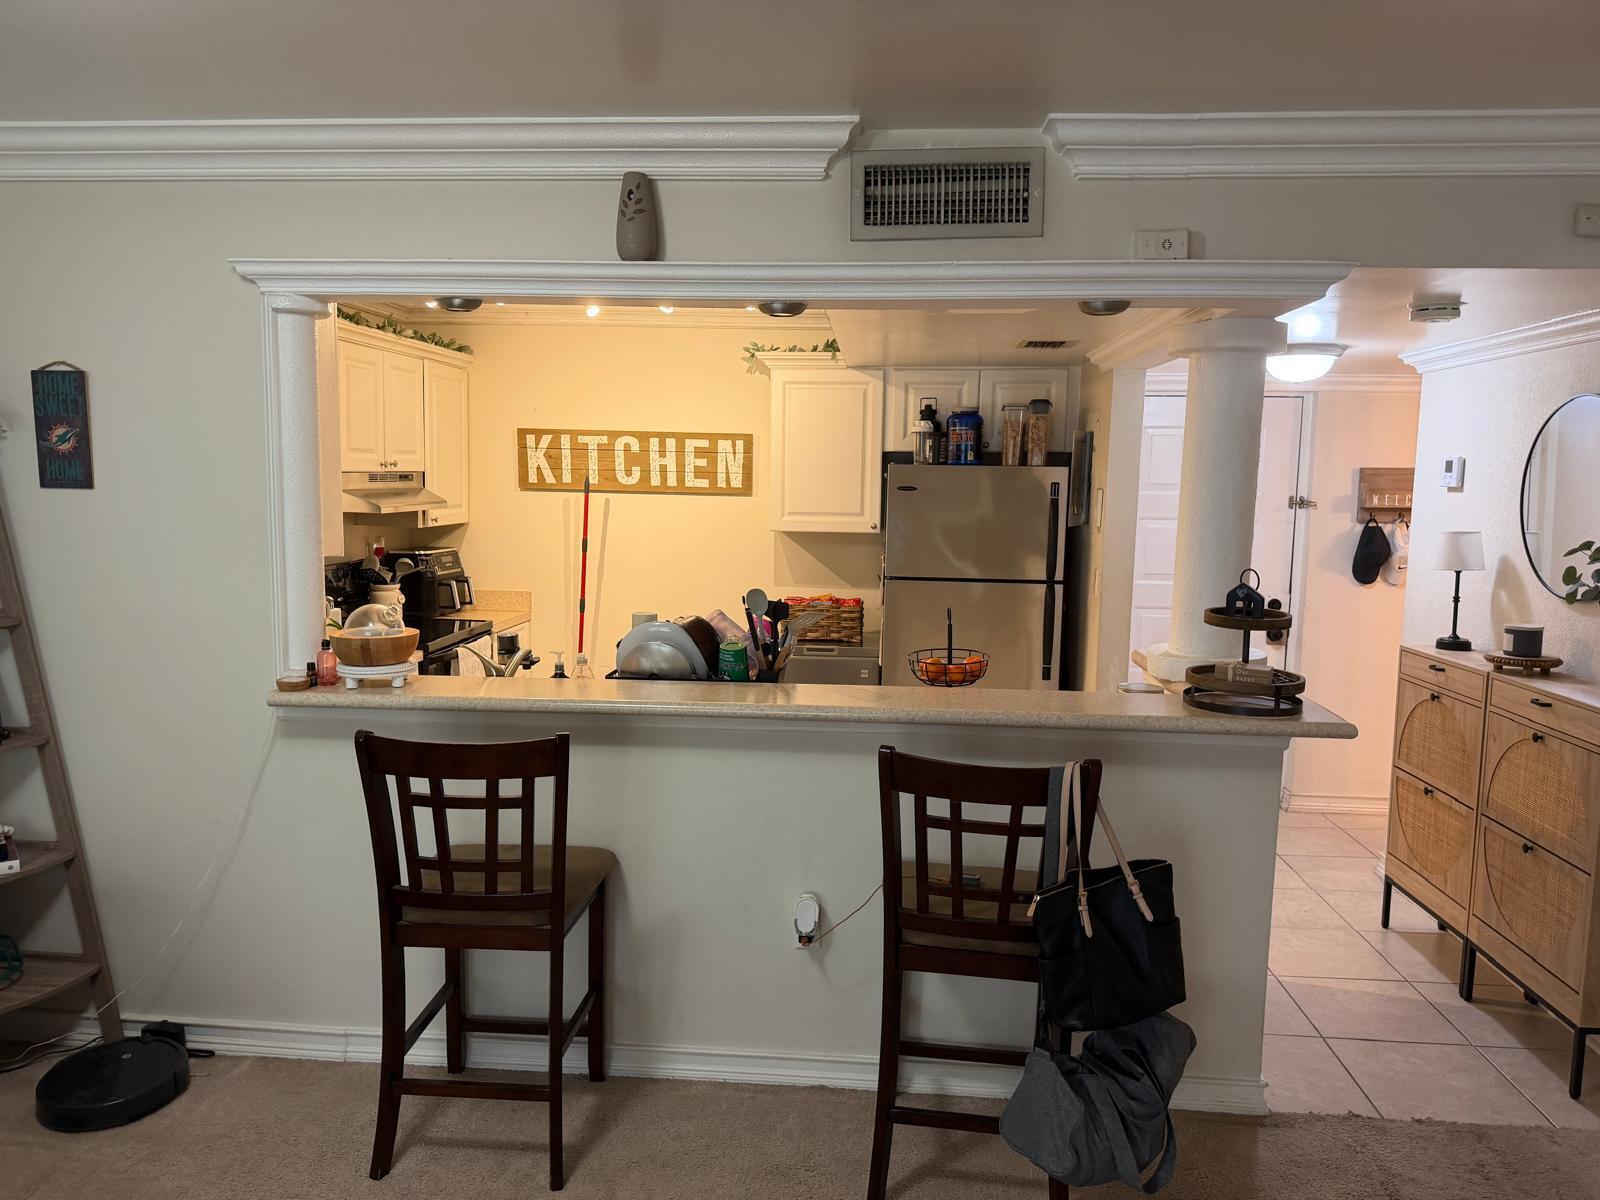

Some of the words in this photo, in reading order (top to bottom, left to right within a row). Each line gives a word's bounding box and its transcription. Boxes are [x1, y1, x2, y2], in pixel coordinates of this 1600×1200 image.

[38, 374, 79, 395] HOME
[35, 394, 85, 417] SWEET
[46, 459, 84, 481] HOME
[525, 434, 744, 489] KITCHEN
